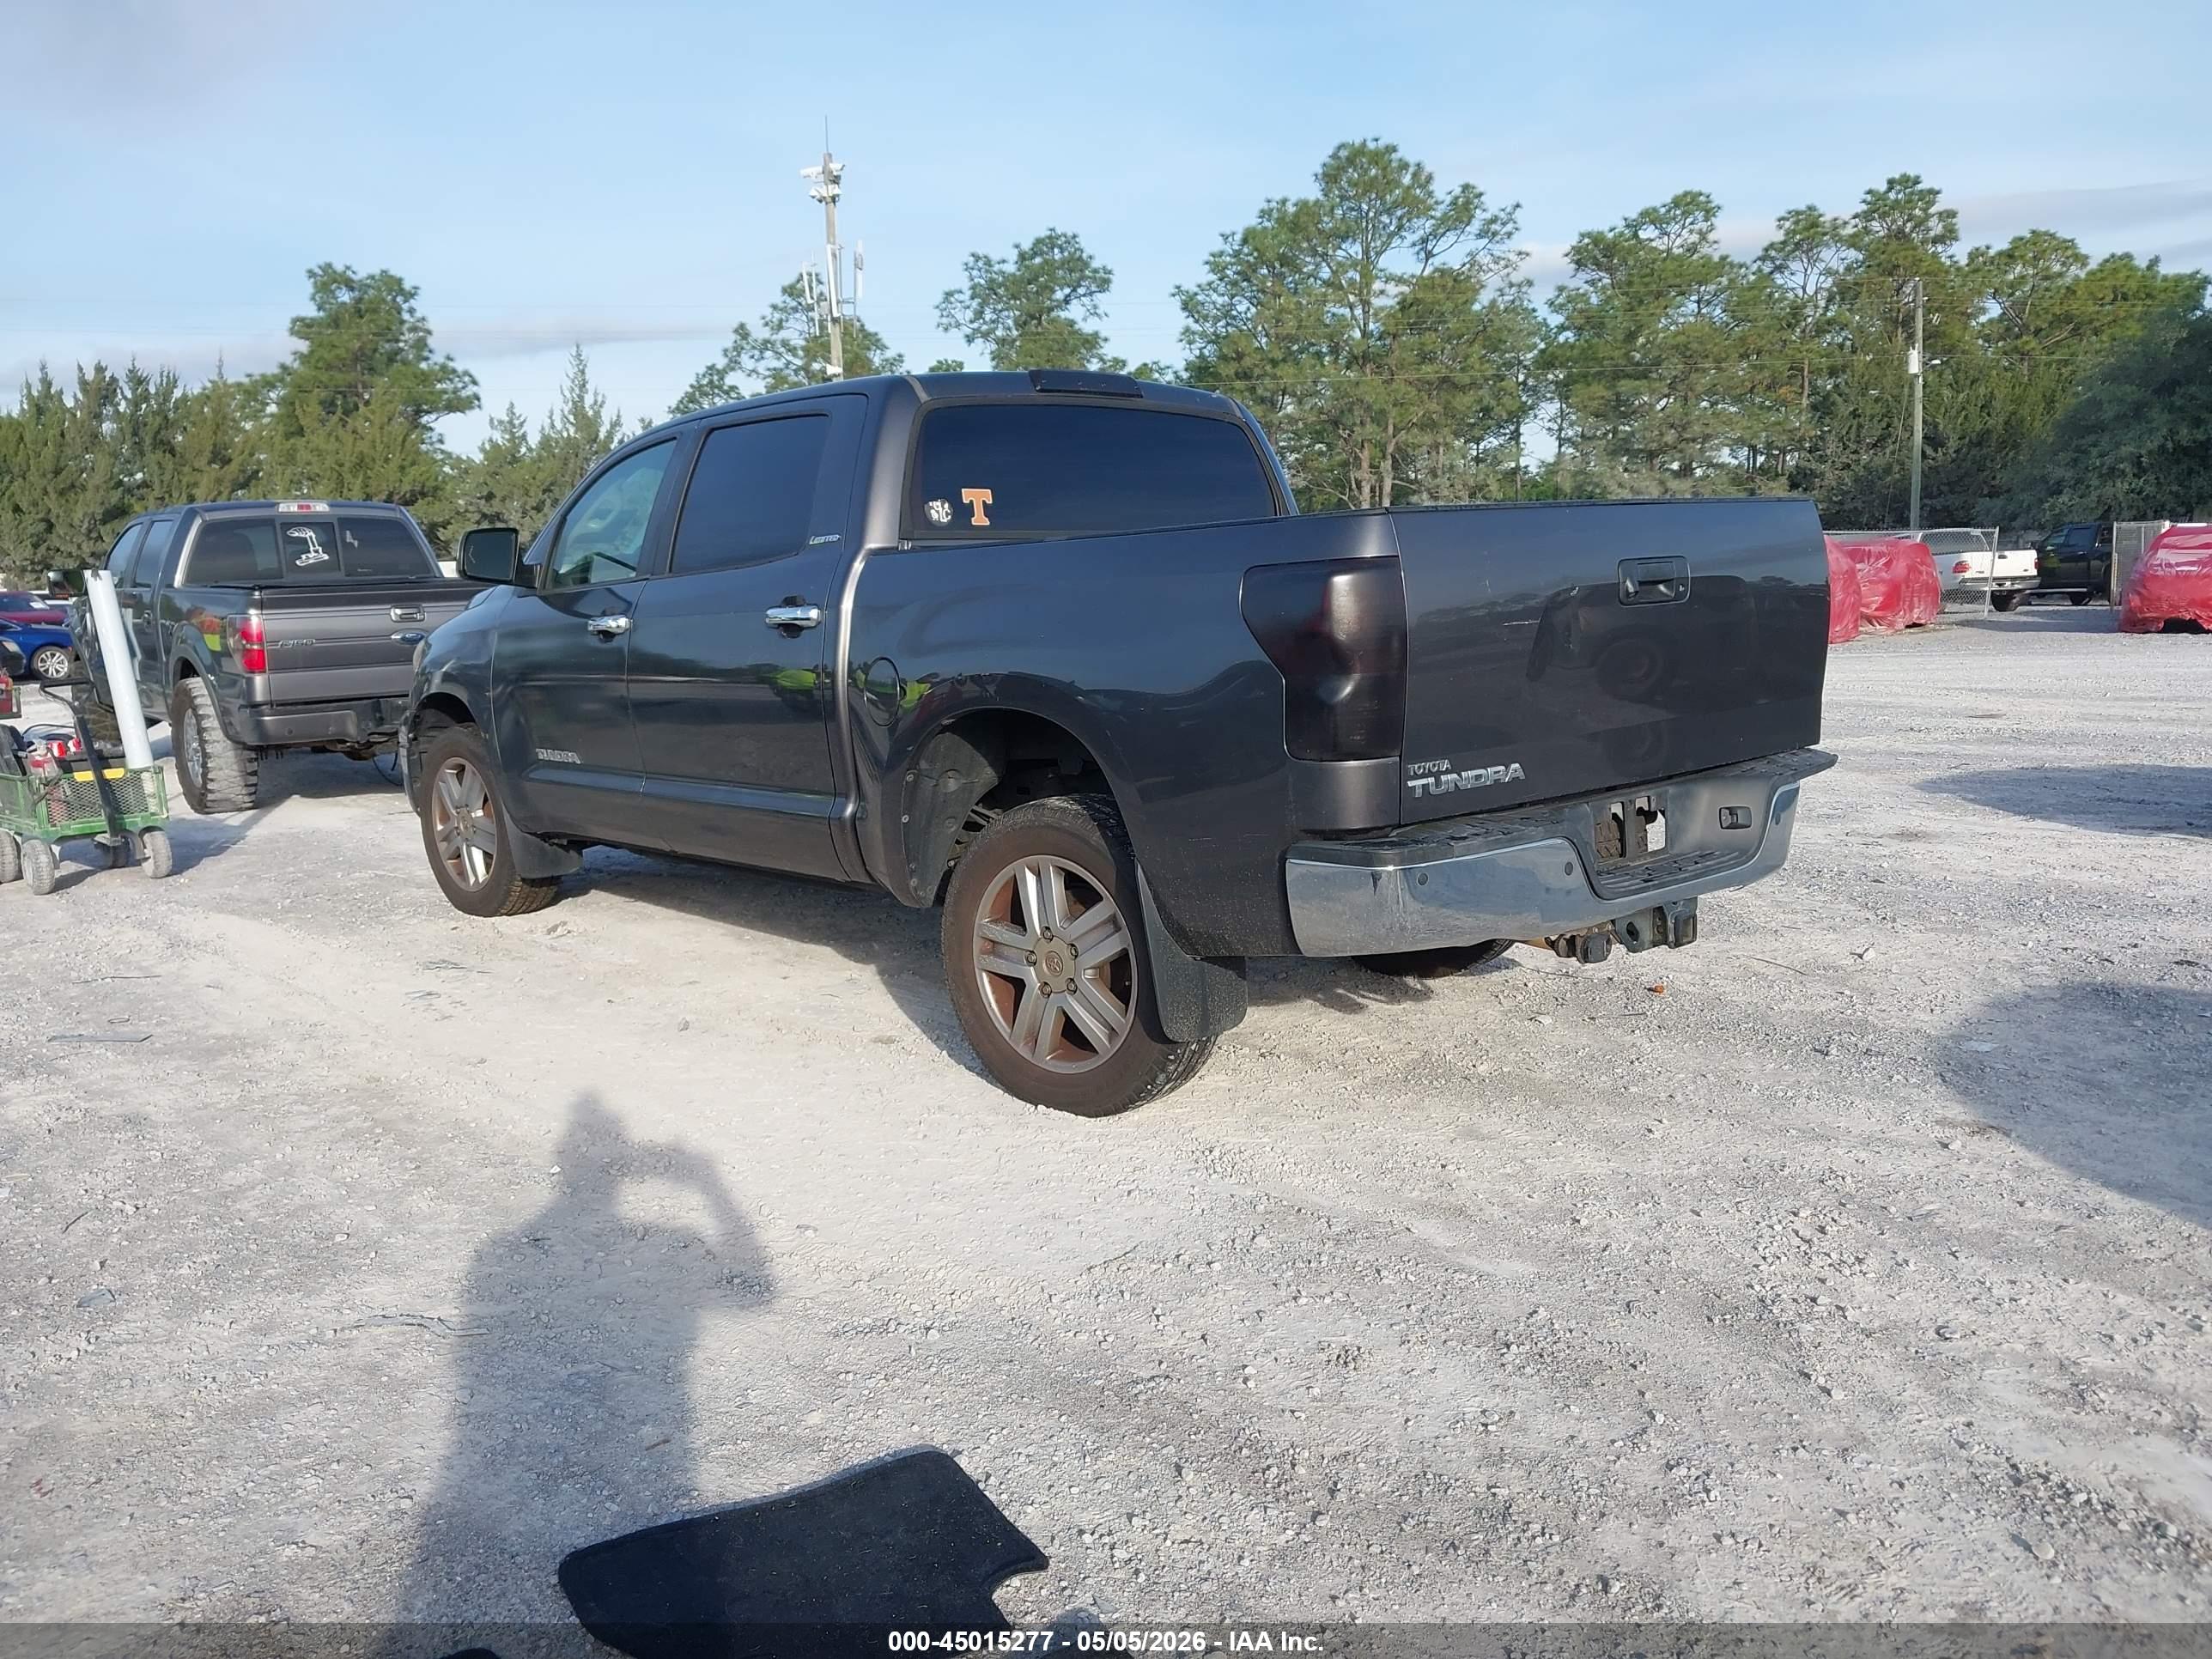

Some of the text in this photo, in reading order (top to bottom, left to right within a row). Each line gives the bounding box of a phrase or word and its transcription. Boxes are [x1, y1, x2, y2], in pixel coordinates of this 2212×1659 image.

[961, 488, 993, 526] T
[1406, 763, 1527, 799] TUNDRA
[1407, 759, 1452, 776] TOYOTA
